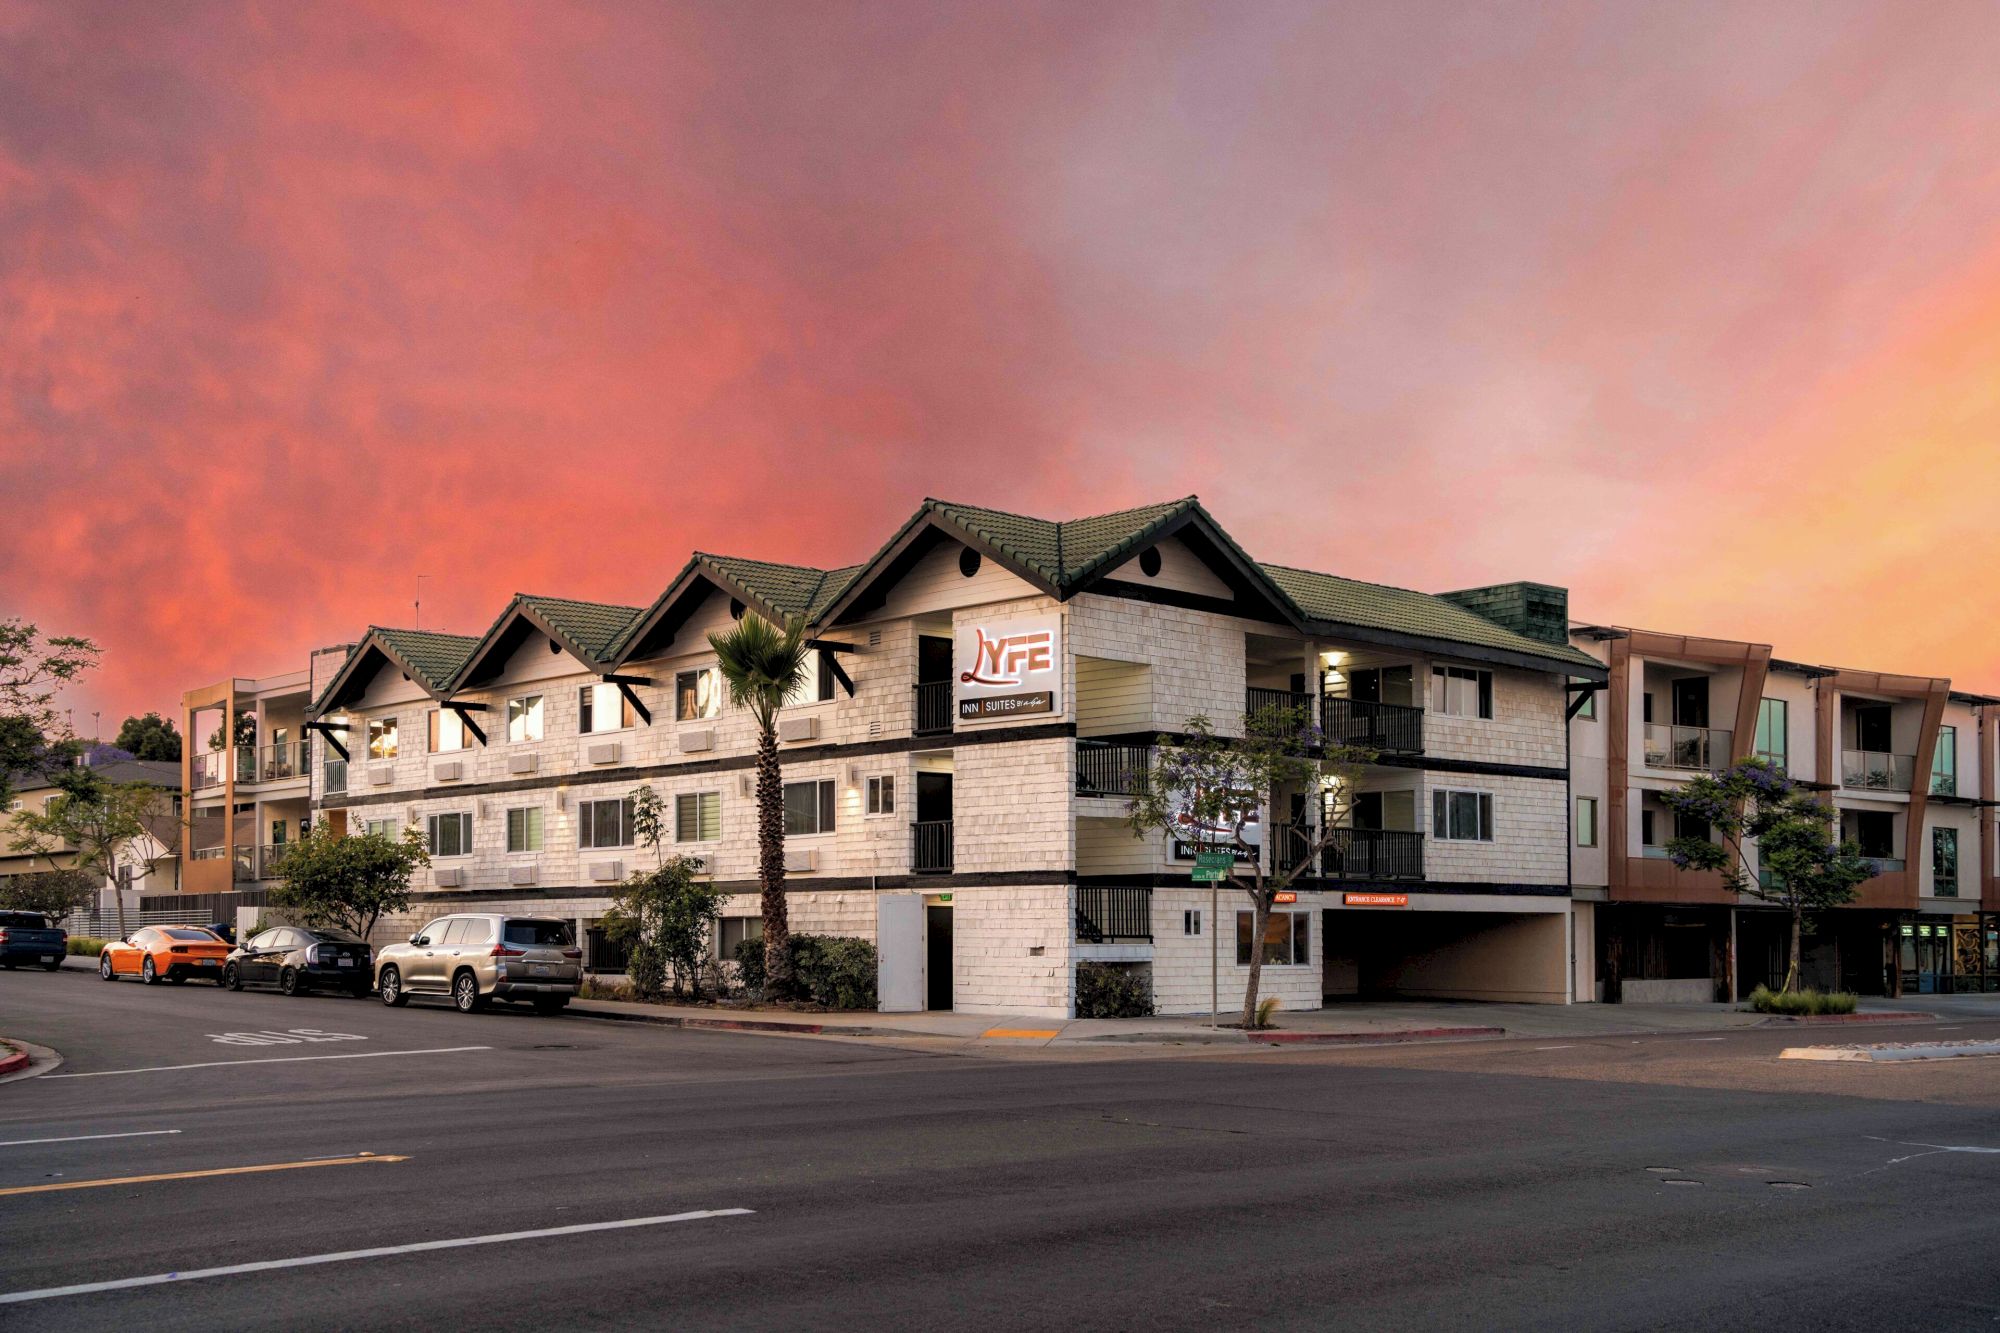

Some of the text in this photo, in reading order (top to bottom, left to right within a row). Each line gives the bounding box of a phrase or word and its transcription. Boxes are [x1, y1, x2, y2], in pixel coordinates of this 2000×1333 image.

[961, 628, 1050, 686] LYFE
[962, 703, 979, 713] INN
[985, 700, 1016, 712] SUITES
[1275, 893, 1295, 901] ACANCY
[1347, 895, 1370, 903] ENTRANCE
[203, 1028, 369, 1046] STOP
